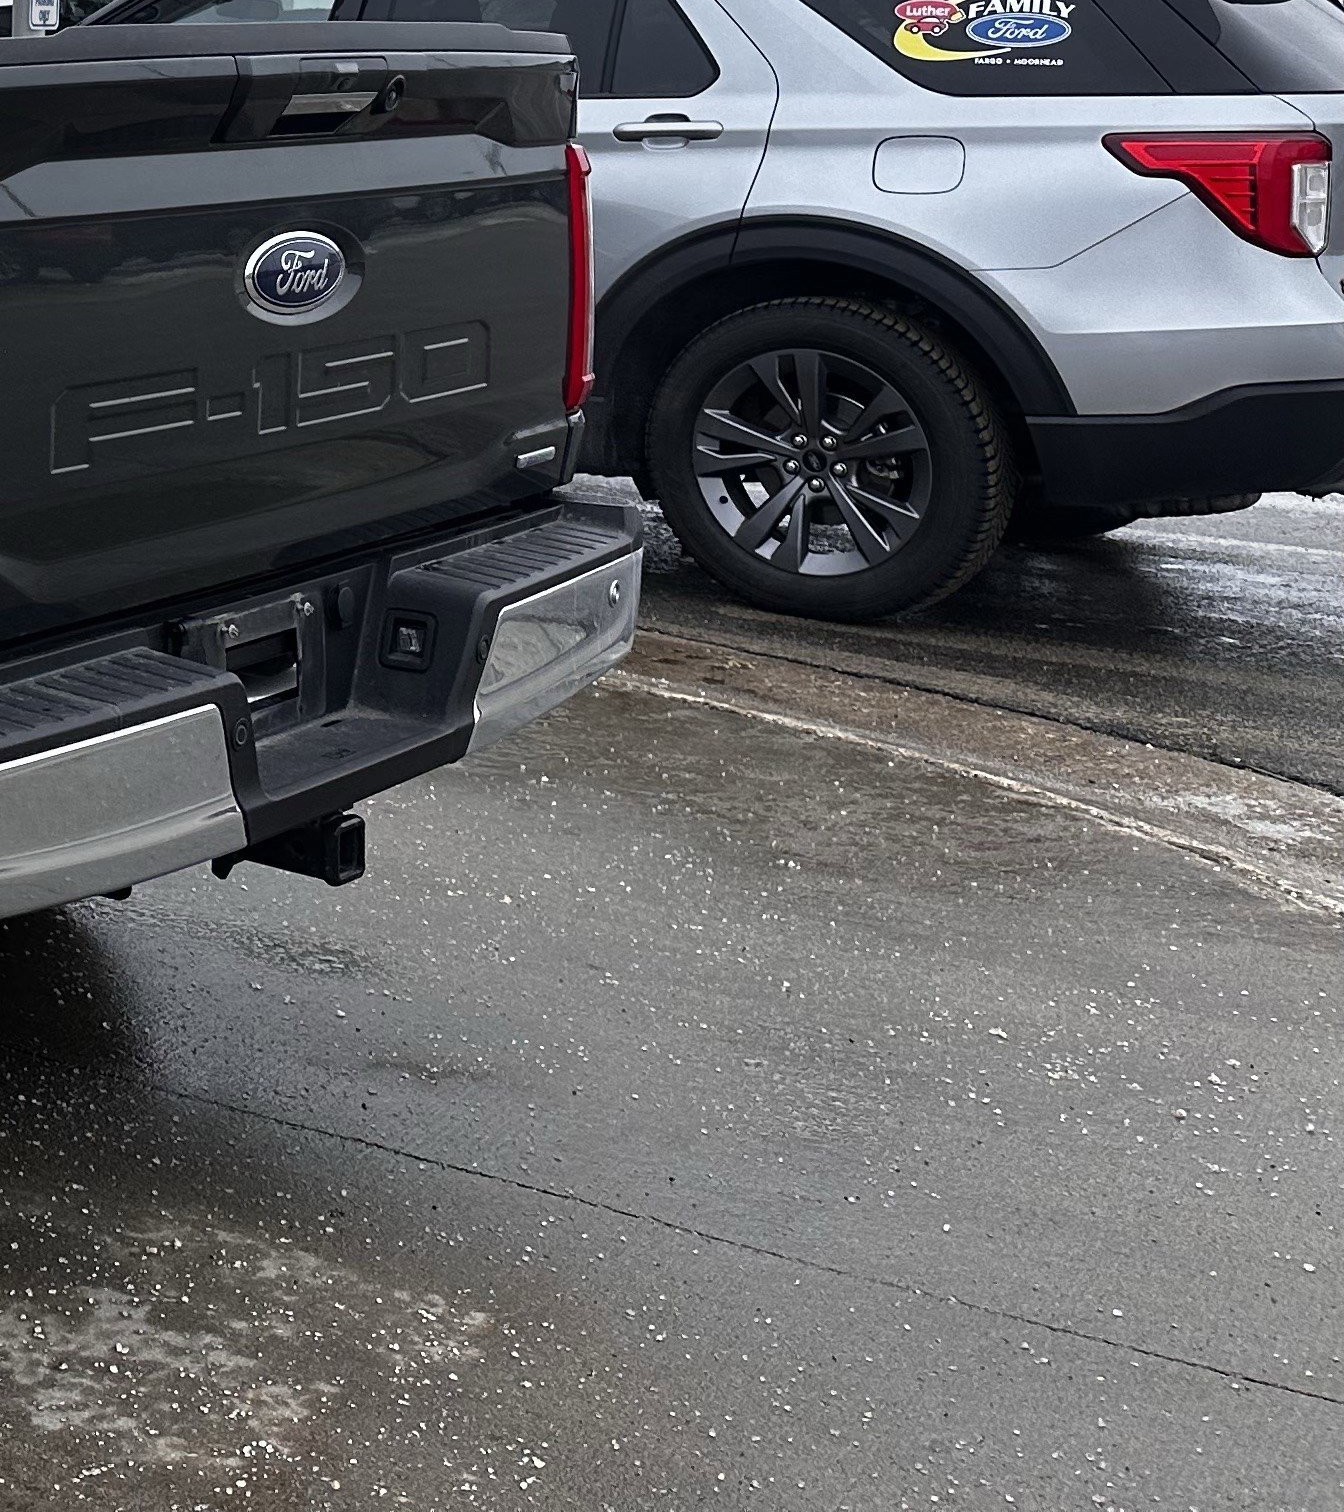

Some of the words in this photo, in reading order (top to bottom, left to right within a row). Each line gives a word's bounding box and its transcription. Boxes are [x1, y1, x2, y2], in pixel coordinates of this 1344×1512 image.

[905, 4, 951, 17] Luther
[987, 17, 1049, 40] Ford
[974, 57, 1003, 65] FARGO
[1013, 58, 1064, 66] MOORHEAD
[275, 249, 330, 296] Ford
[50, 319, 492, 475] F-150
